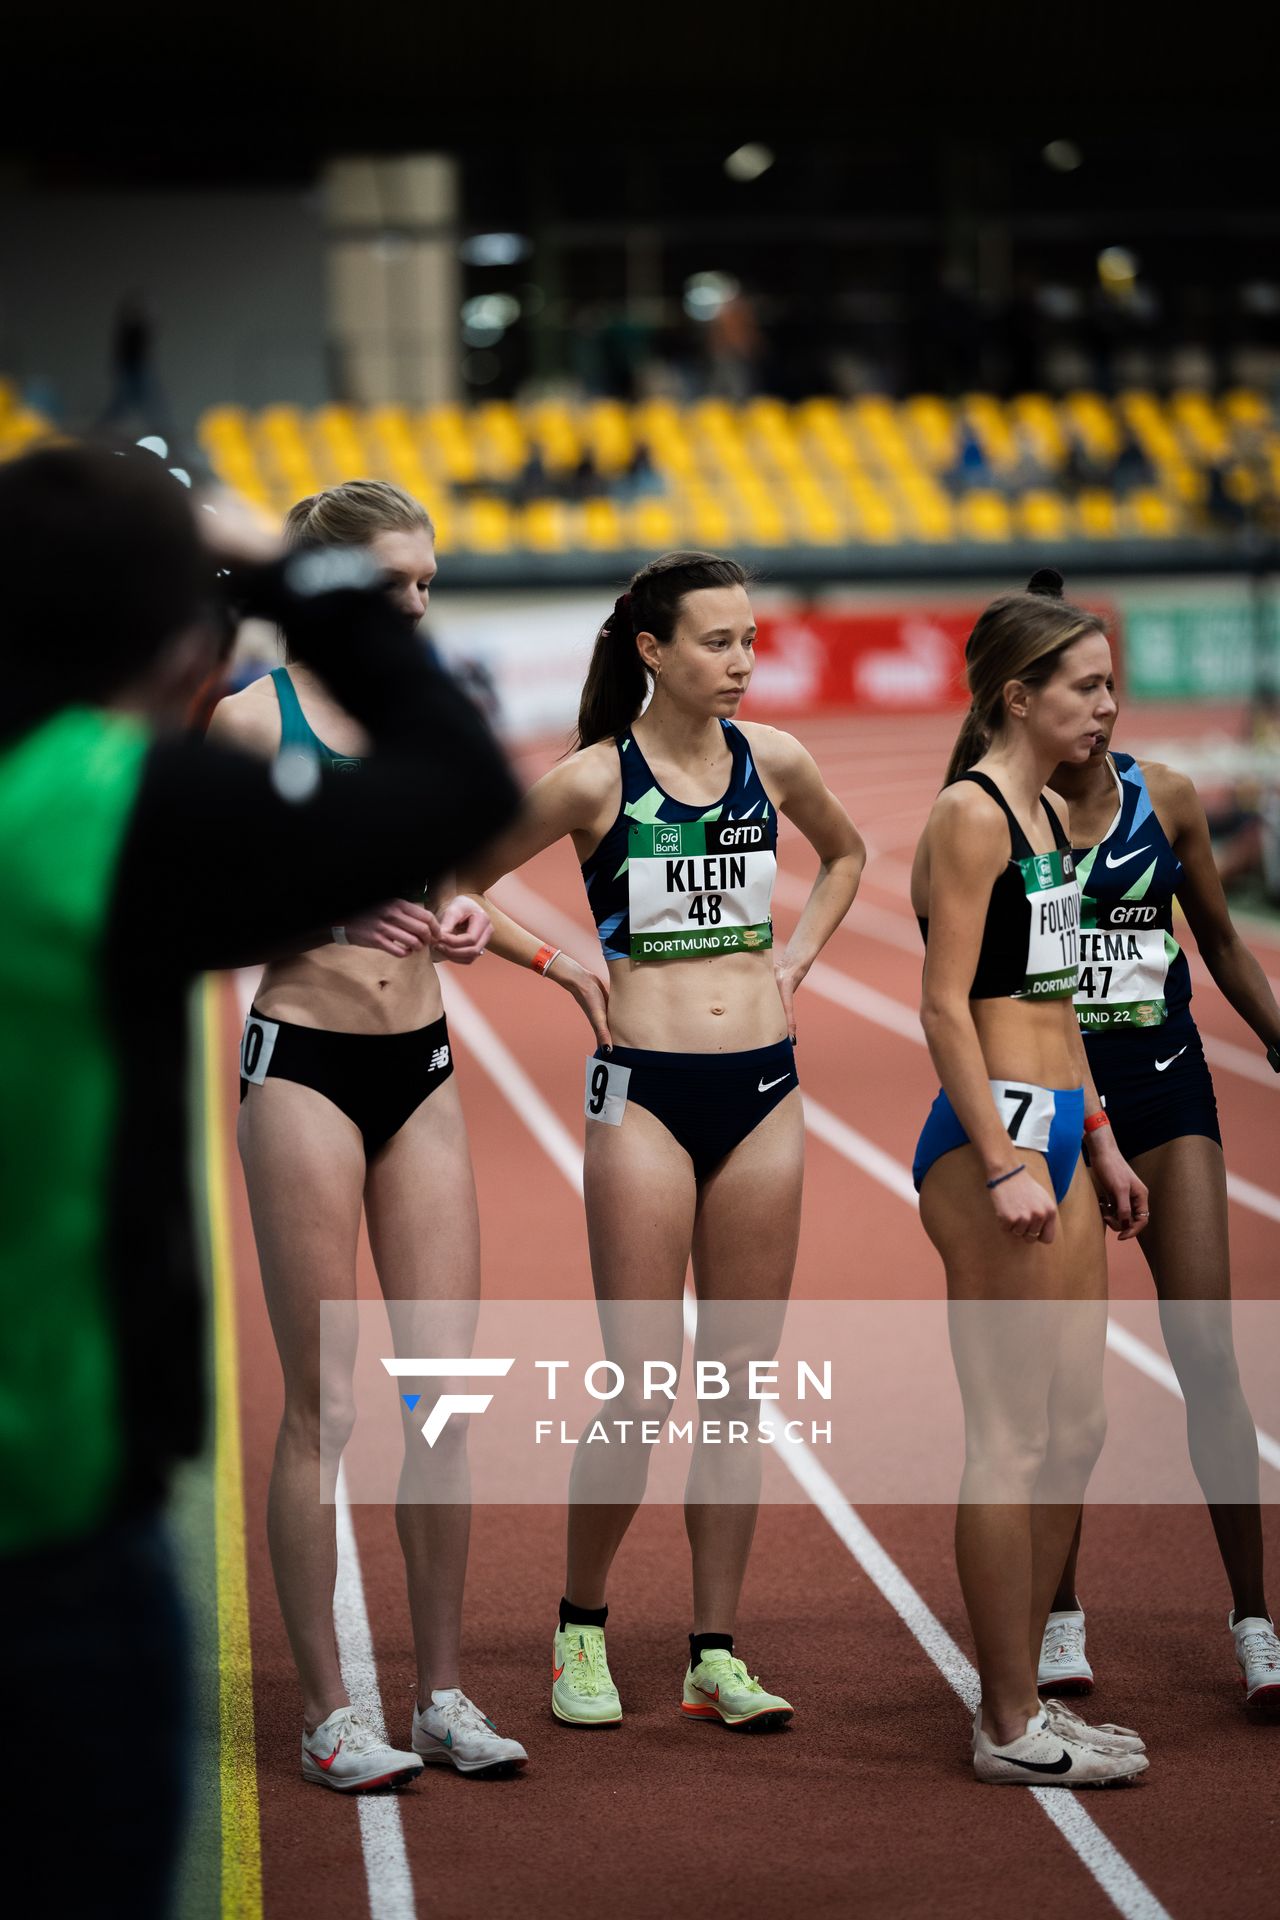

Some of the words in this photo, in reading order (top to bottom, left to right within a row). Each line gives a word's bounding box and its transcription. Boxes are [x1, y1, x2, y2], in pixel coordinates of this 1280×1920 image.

[656, 844, 679, 852] Bank
[719, 826, 762, 845] GfTD
[666, 856, 746, 893] KLEIN
[688, 894, 722, 926] 48
[1109, 906, 1157, 924] GfTD
[643, 936, 720, 953] DORTMUND
[722, 935, 739, 947] 22
[1078, 967, 1113, 998] 47
[1113, 1010, 1132, 1022] 22
[590, 1064, 609, 1114] 9
[1004, 1089, 1033, 1141] 7
